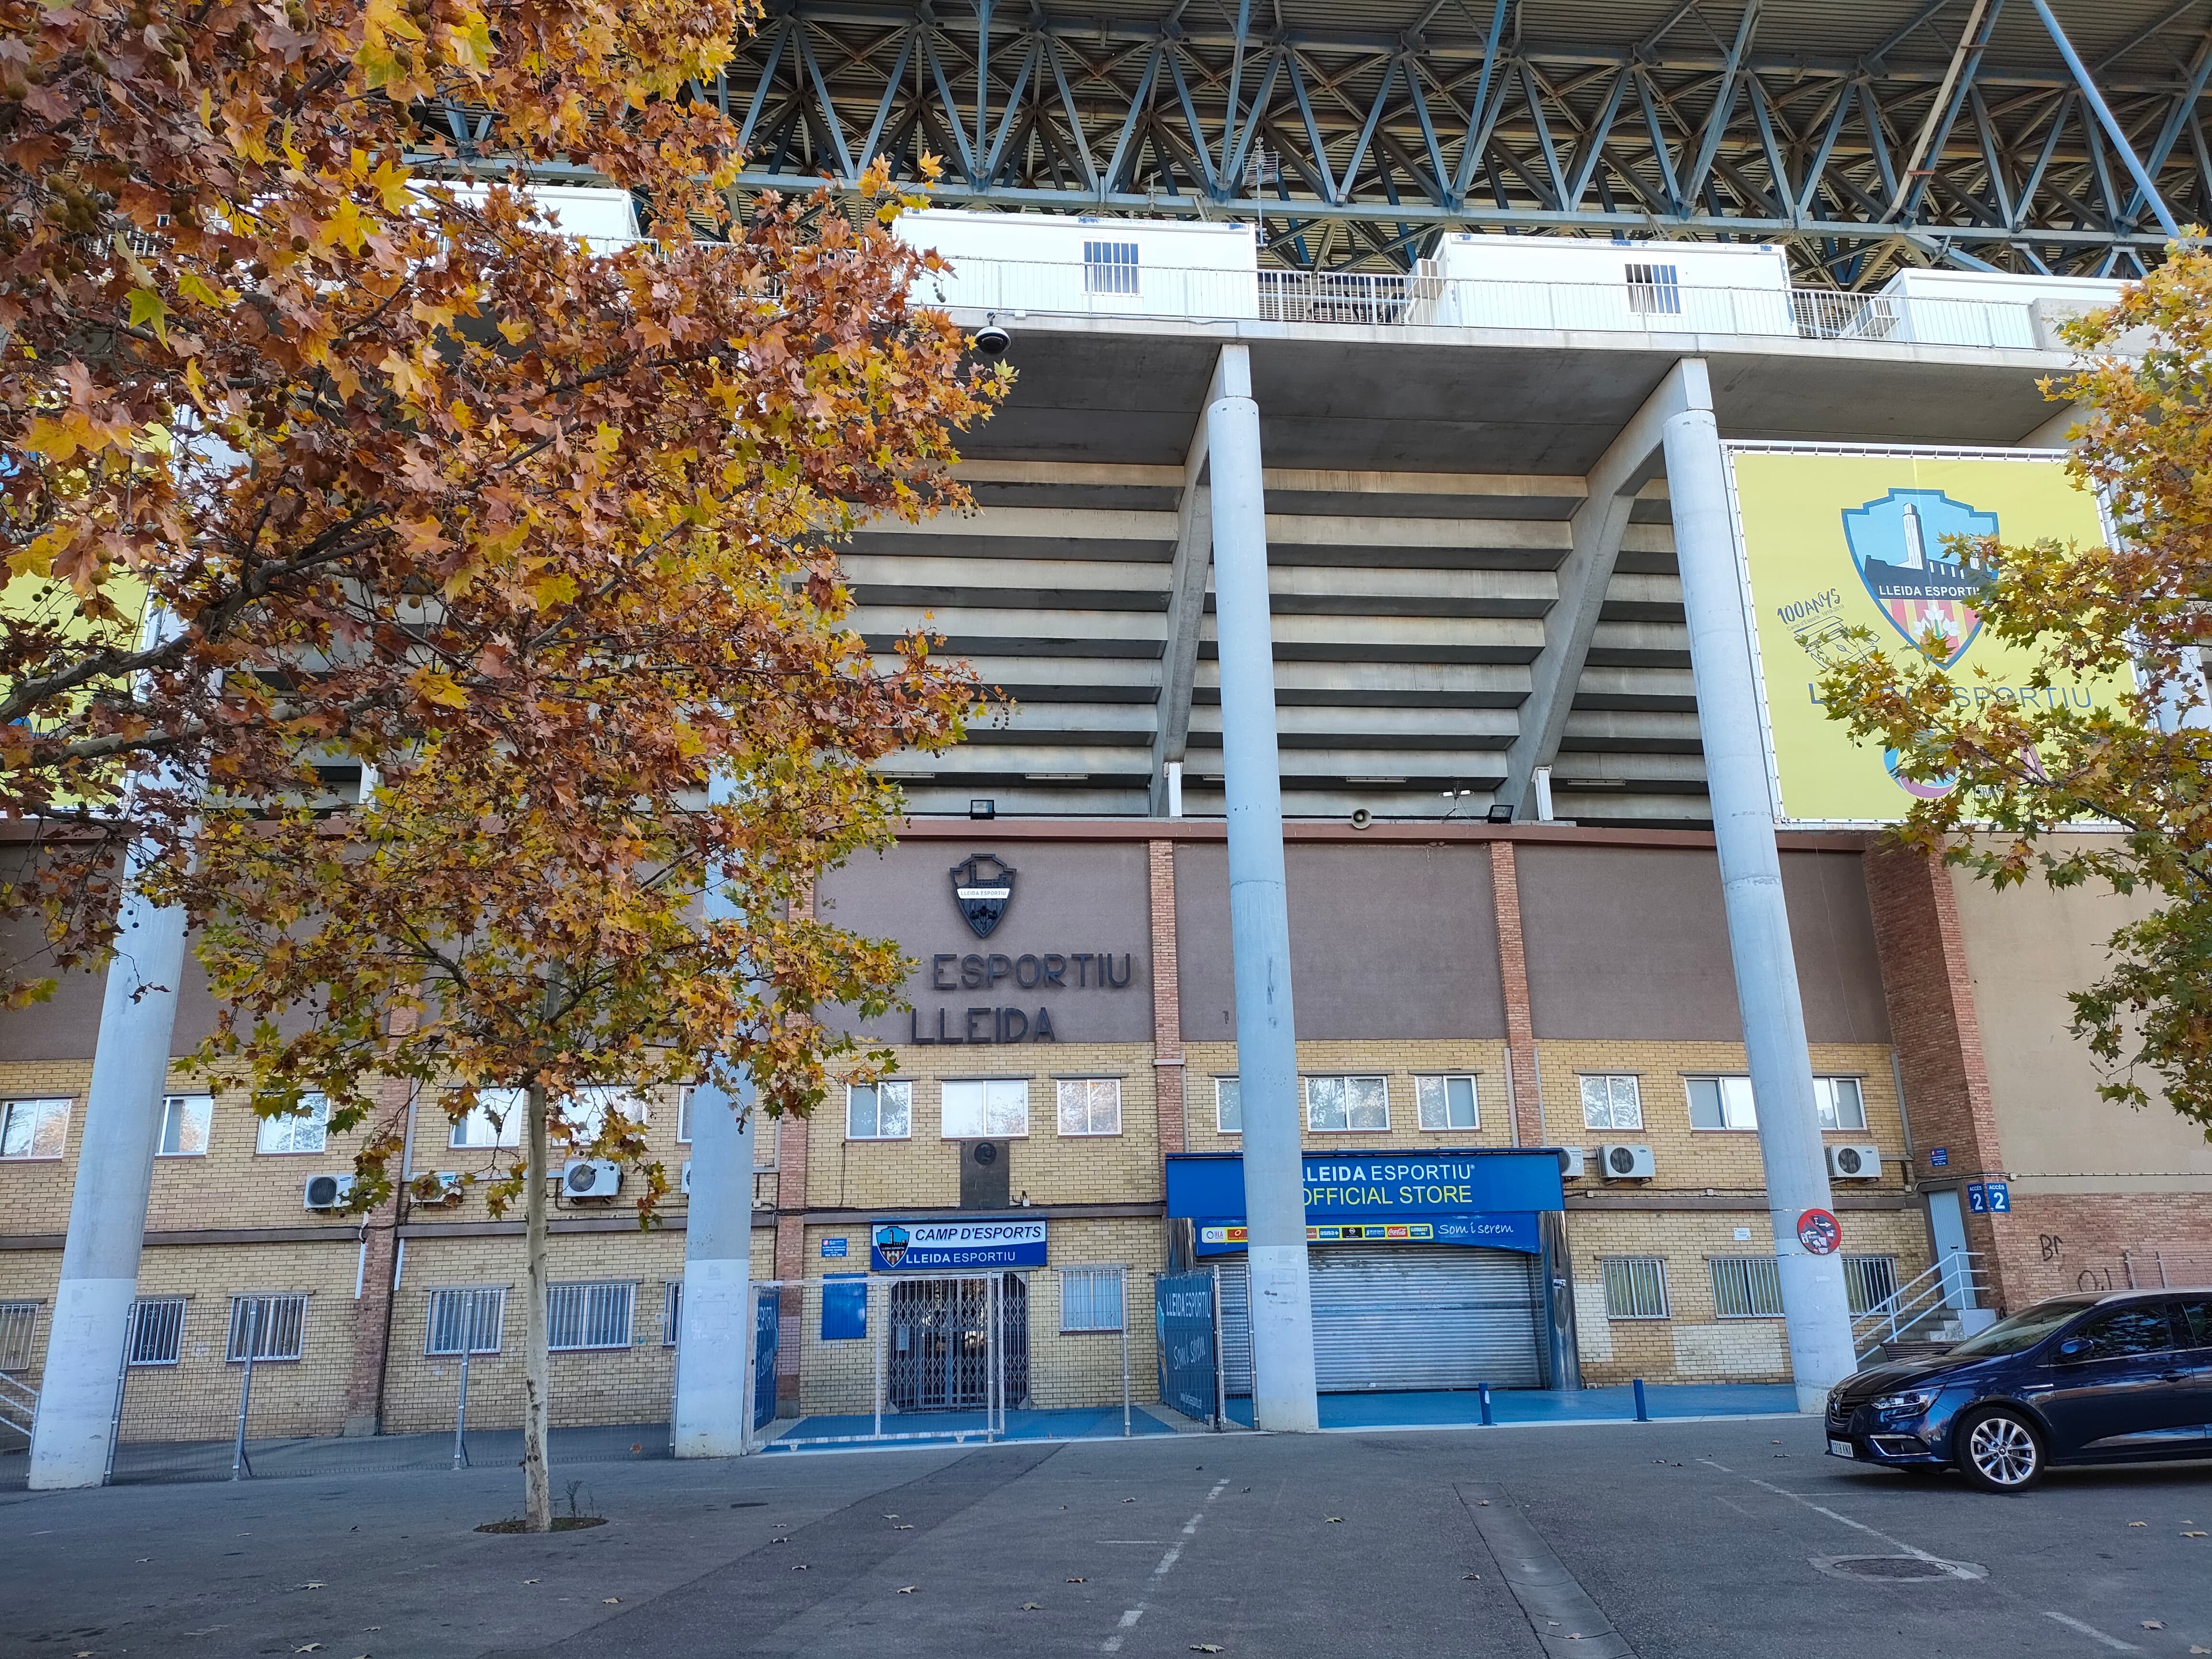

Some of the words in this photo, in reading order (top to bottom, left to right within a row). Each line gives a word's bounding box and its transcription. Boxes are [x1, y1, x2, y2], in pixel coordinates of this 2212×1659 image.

[1878, 585, 1922, 596] LLEIDA
[1925, 586, 1980, 597] ESPORTI
[933, 953, 1131, 989] ESPORTIU
[911, 1007, 1056, 1044] LLEIDA
[1302, 1165, 1366, 1181] LEIDA
[1399, 1185, 1473, 1204] STORE
[1973, 1193, 1983, 1210] 2
[1993, 1192, 2005, 1209] 2
[915, 1228, 957, 1241] CAMP
[960, 1226, 1041, 1240] D'ESPORTS
[1438, 1224, 1468, 1234] Som
[1470, 1221, 1476, 1234] i
[1478, 1224, 1514, 1234] serem
[906, 1253, 950, 1264] LLEIDA
[953, 1252, 1016, 1263] ESPORTIU
[1165, 1293, 1185, 1317] LLEIDA
[1185, 1291, 1211, 1319] ESPORTIU
